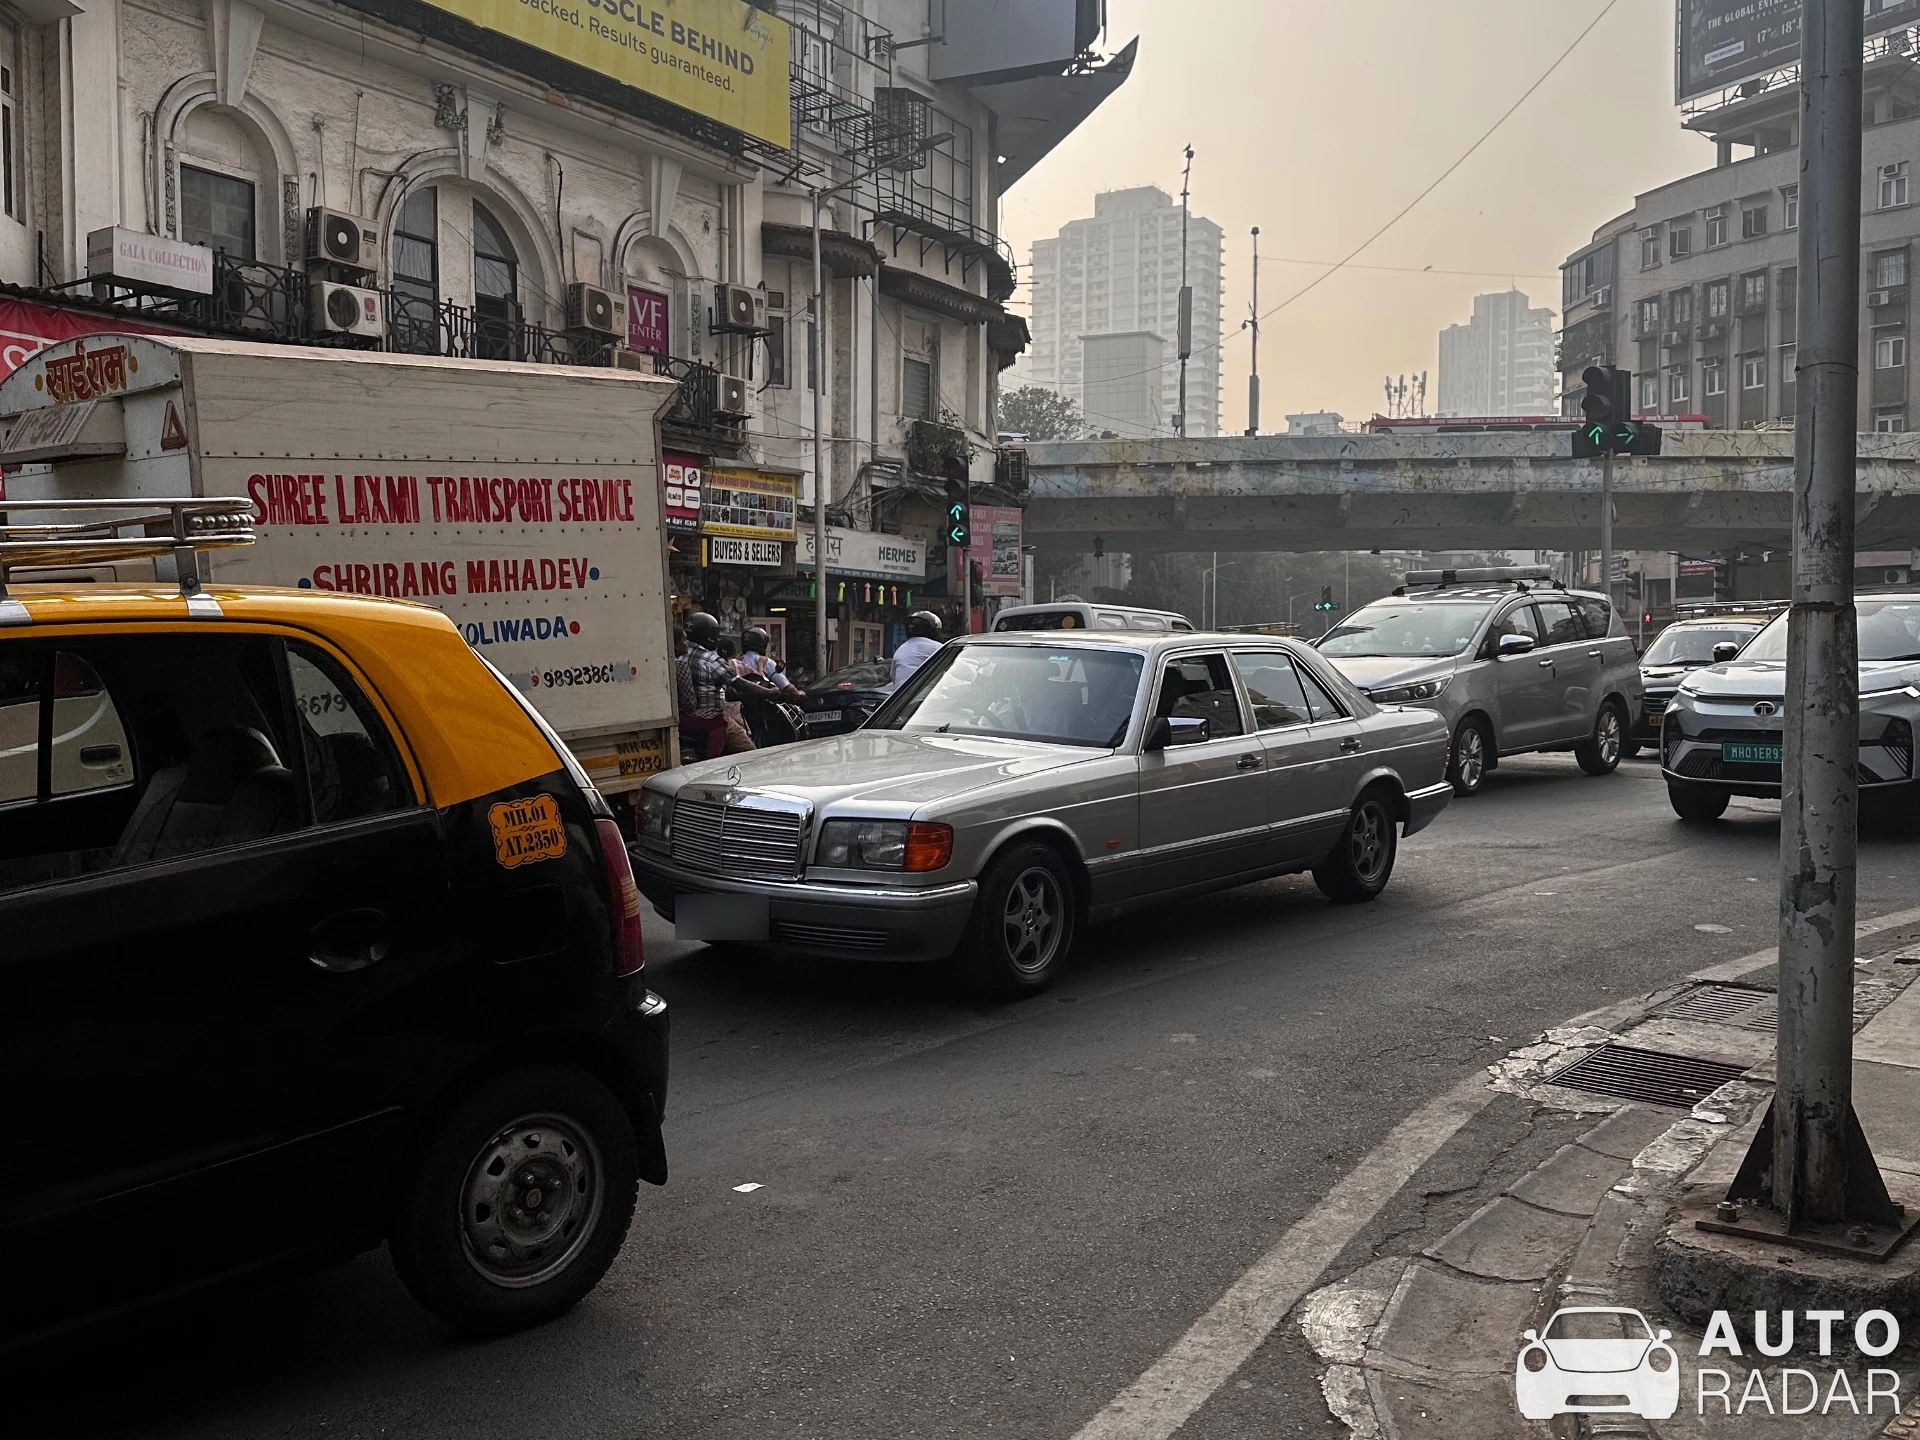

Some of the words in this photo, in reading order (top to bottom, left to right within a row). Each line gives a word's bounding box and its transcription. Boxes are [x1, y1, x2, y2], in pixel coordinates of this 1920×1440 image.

[1707, 16, 1722, 30] THE
[1724, 4, 1755, 24] GLOBAL
[580, 0, 665, 38] SCLE
[670, 20, 754, 76] BEHIND
[589, 16, 647, 55] Results
[650, 46, 735, 94] guaranteed.
[120, 241, 146, 261] GALA
[148, 248, 208, 274] COLLECTION
[628, 295, 662, 329] VF
[247, 474, 330, 526] SHREE
[334, 474, 421, 525] LAXMI
[426, 476, 553, 524] TRANSPORT
[557, 478, 635, 523] SERVICE
[714, 540, 743, 562] BUYERS
[744, 542, 750, 561] &
[751, 542, 781, 563] SELLERS
[878, 546, 917, 564] HERMES
[312, 560, 457, 598] SHRIRANG
[466, 557, 589, 594] MAHADEV
[543, 662, 616, 689] 9892386
[503, 804, 548, 828] MH.01
[505, 827, 559, 858] AT.2350
